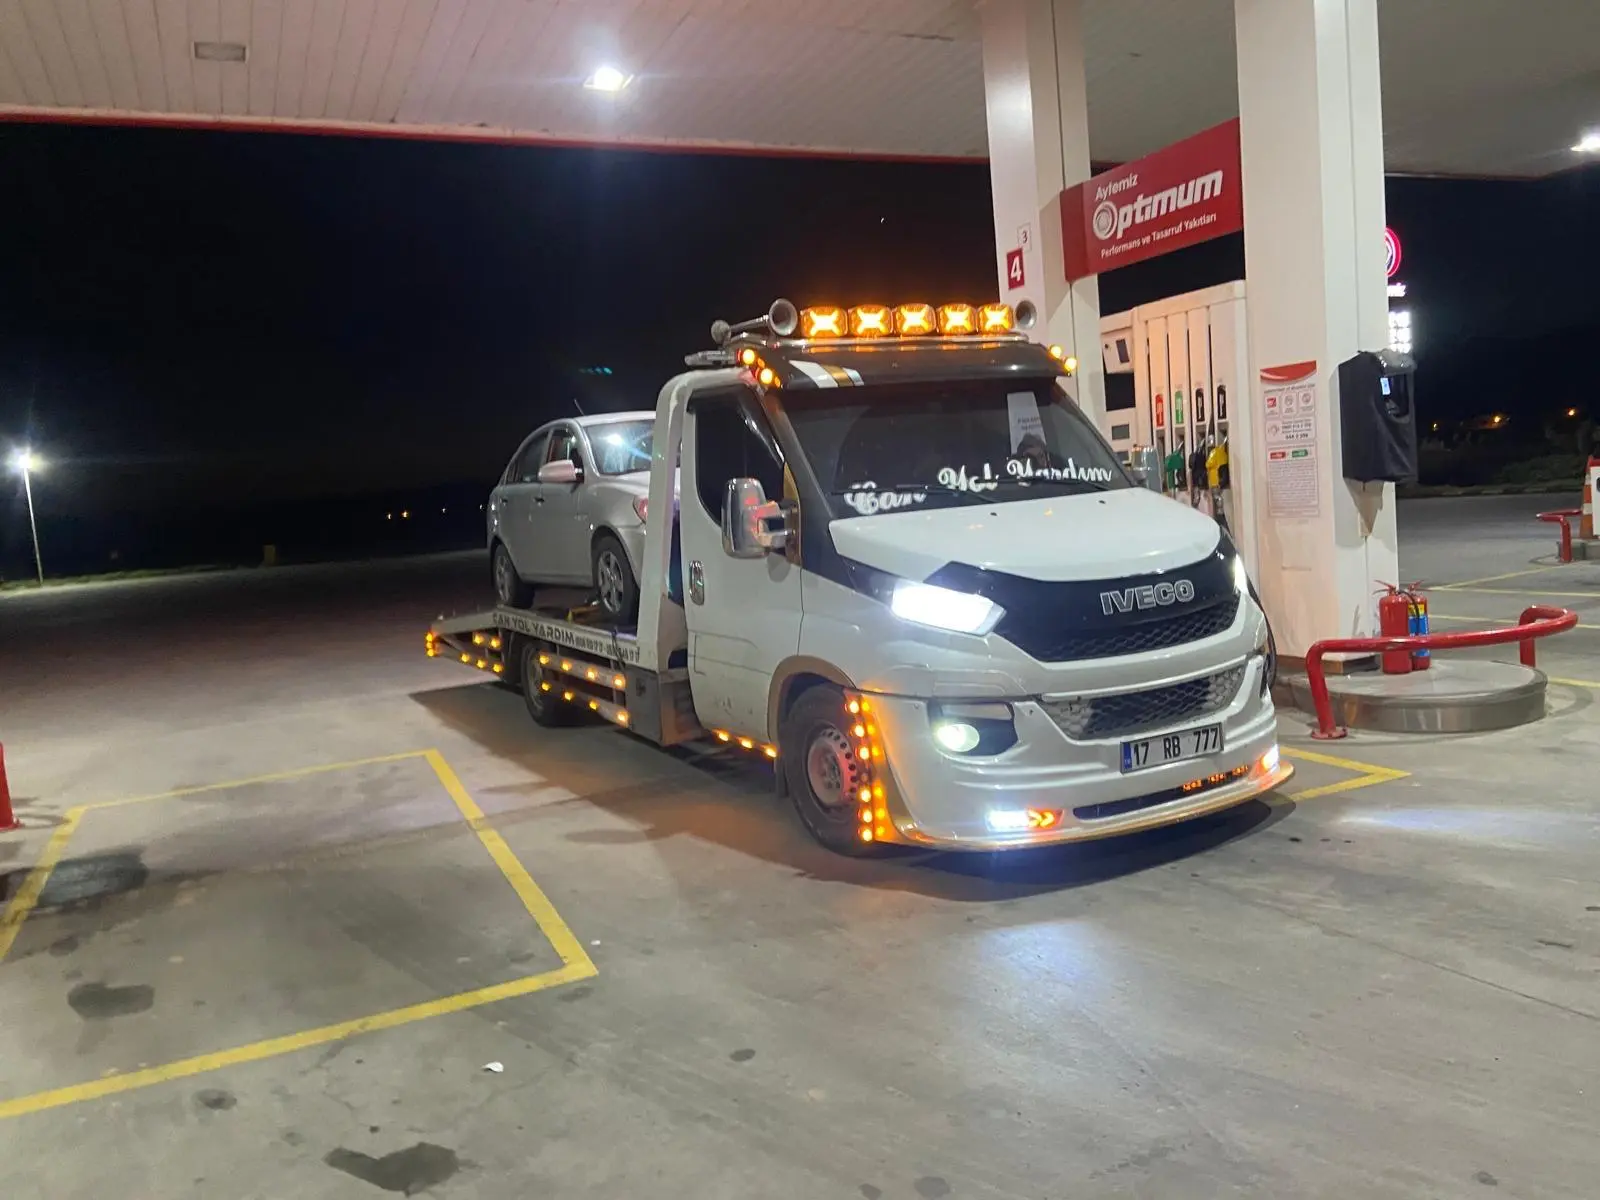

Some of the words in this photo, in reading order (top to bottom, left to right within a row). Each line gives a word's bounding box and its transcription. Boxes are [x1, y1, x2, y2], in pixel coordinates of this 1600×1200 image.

[1096, 173, 1138, 201] Aytemiz
[1093, 170, 1223, 240] Optimum
[1022, 230, 1028, 244] 3
[1101, 239, 1140, 258] Performans
[1142, 235, 1151, 245] ve
[1152, 222, 1182, 241] Tasarruf
[1010, 256, 1022, 282] 4
[1100, 579, 1195, 615] IVECO
[511, 615, 531, 632] YOL
[532, 622, 575, 645] YARDIM
[1134, 741, 1149, 766] 17
[1163, 735, 1181, 759] RB
[1193, 727, 1218, 753] 777
